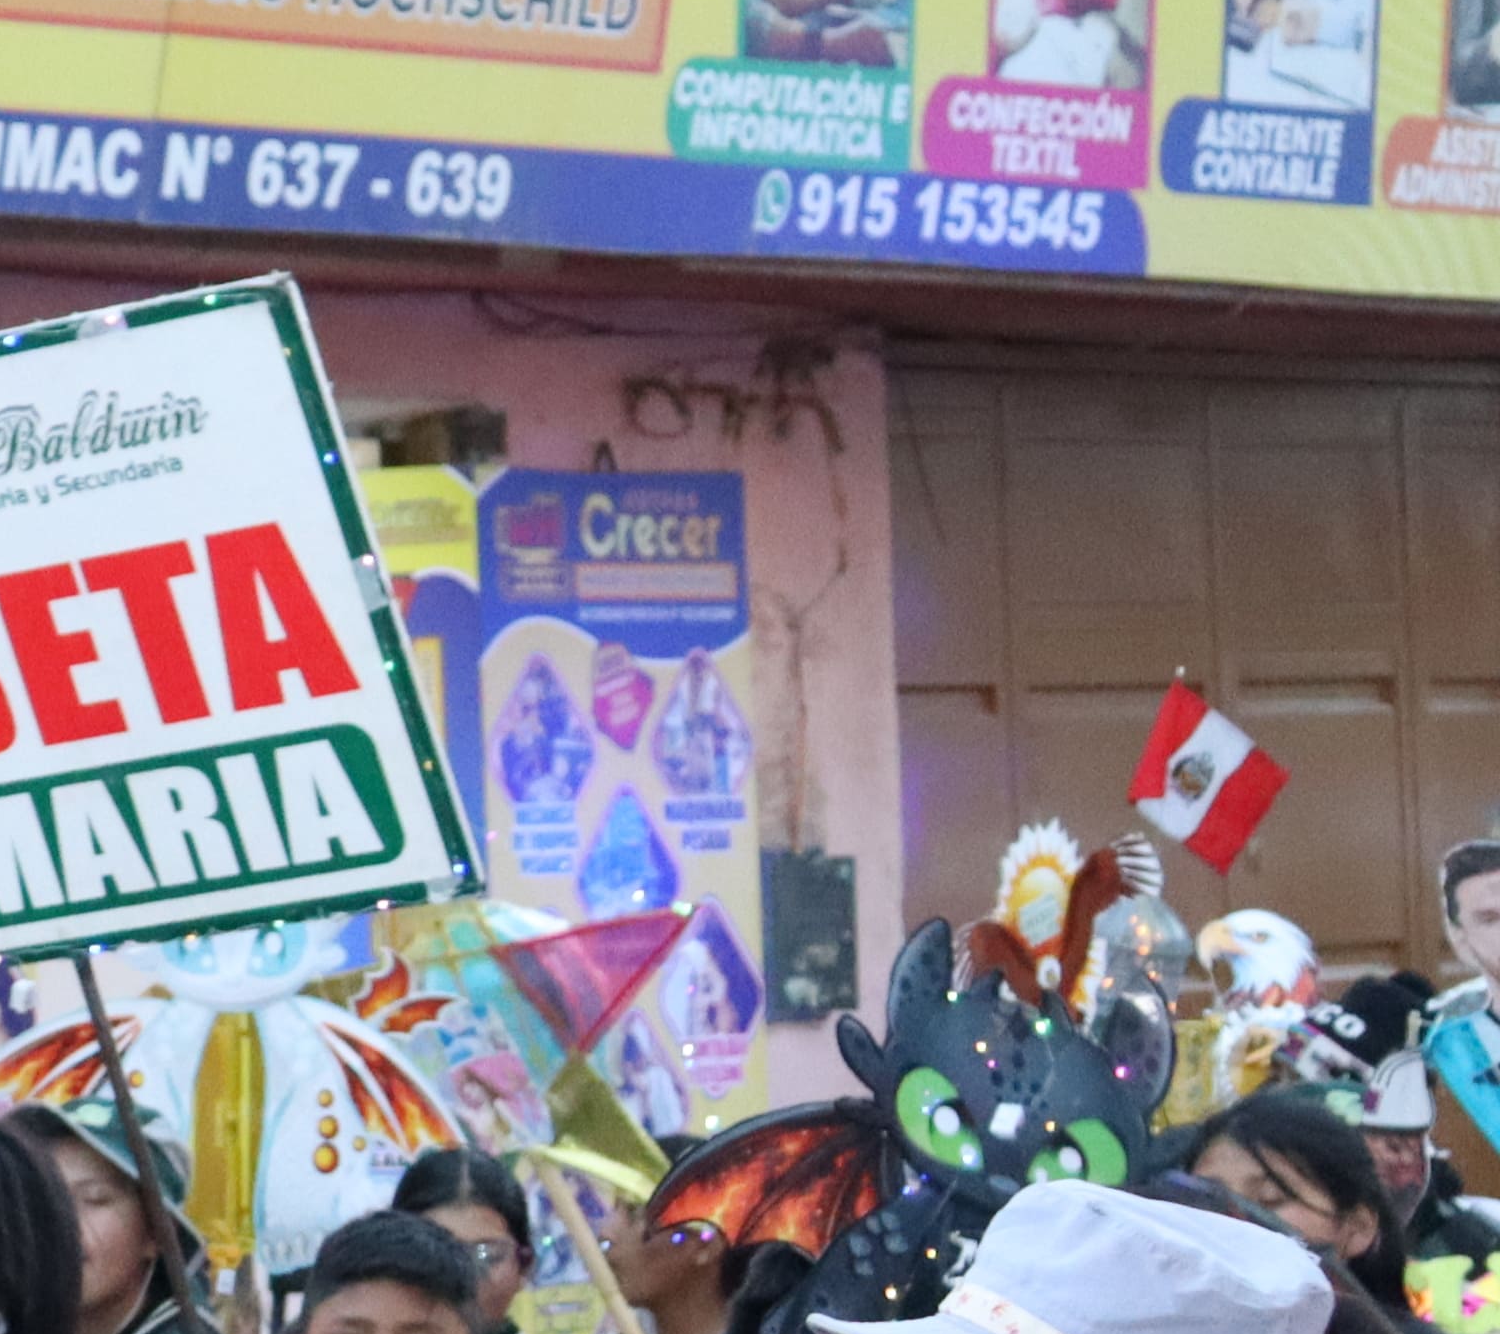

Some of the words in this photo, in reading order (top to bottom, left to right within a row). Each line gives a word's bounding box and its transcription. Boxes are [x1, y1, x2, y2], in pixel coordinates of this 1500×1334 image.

[889, 82, 911, 122] E
[990, 136, 1081, 180] TEXTIL
[1196, 110, 1346, 157] ASISTENTE
[247, 140, 362, 211] 637
[404, 149, 514, 221] 639
[1191, 150, 1340, 199] CONTABLE
[798, 172, 899, 238] 915
[915, 179, 1105, 251] 153545
[35, 485, 52, 507] y
[54, 453, 184, 498] Secundaria
[579, 492, 722, 558] Crecer
